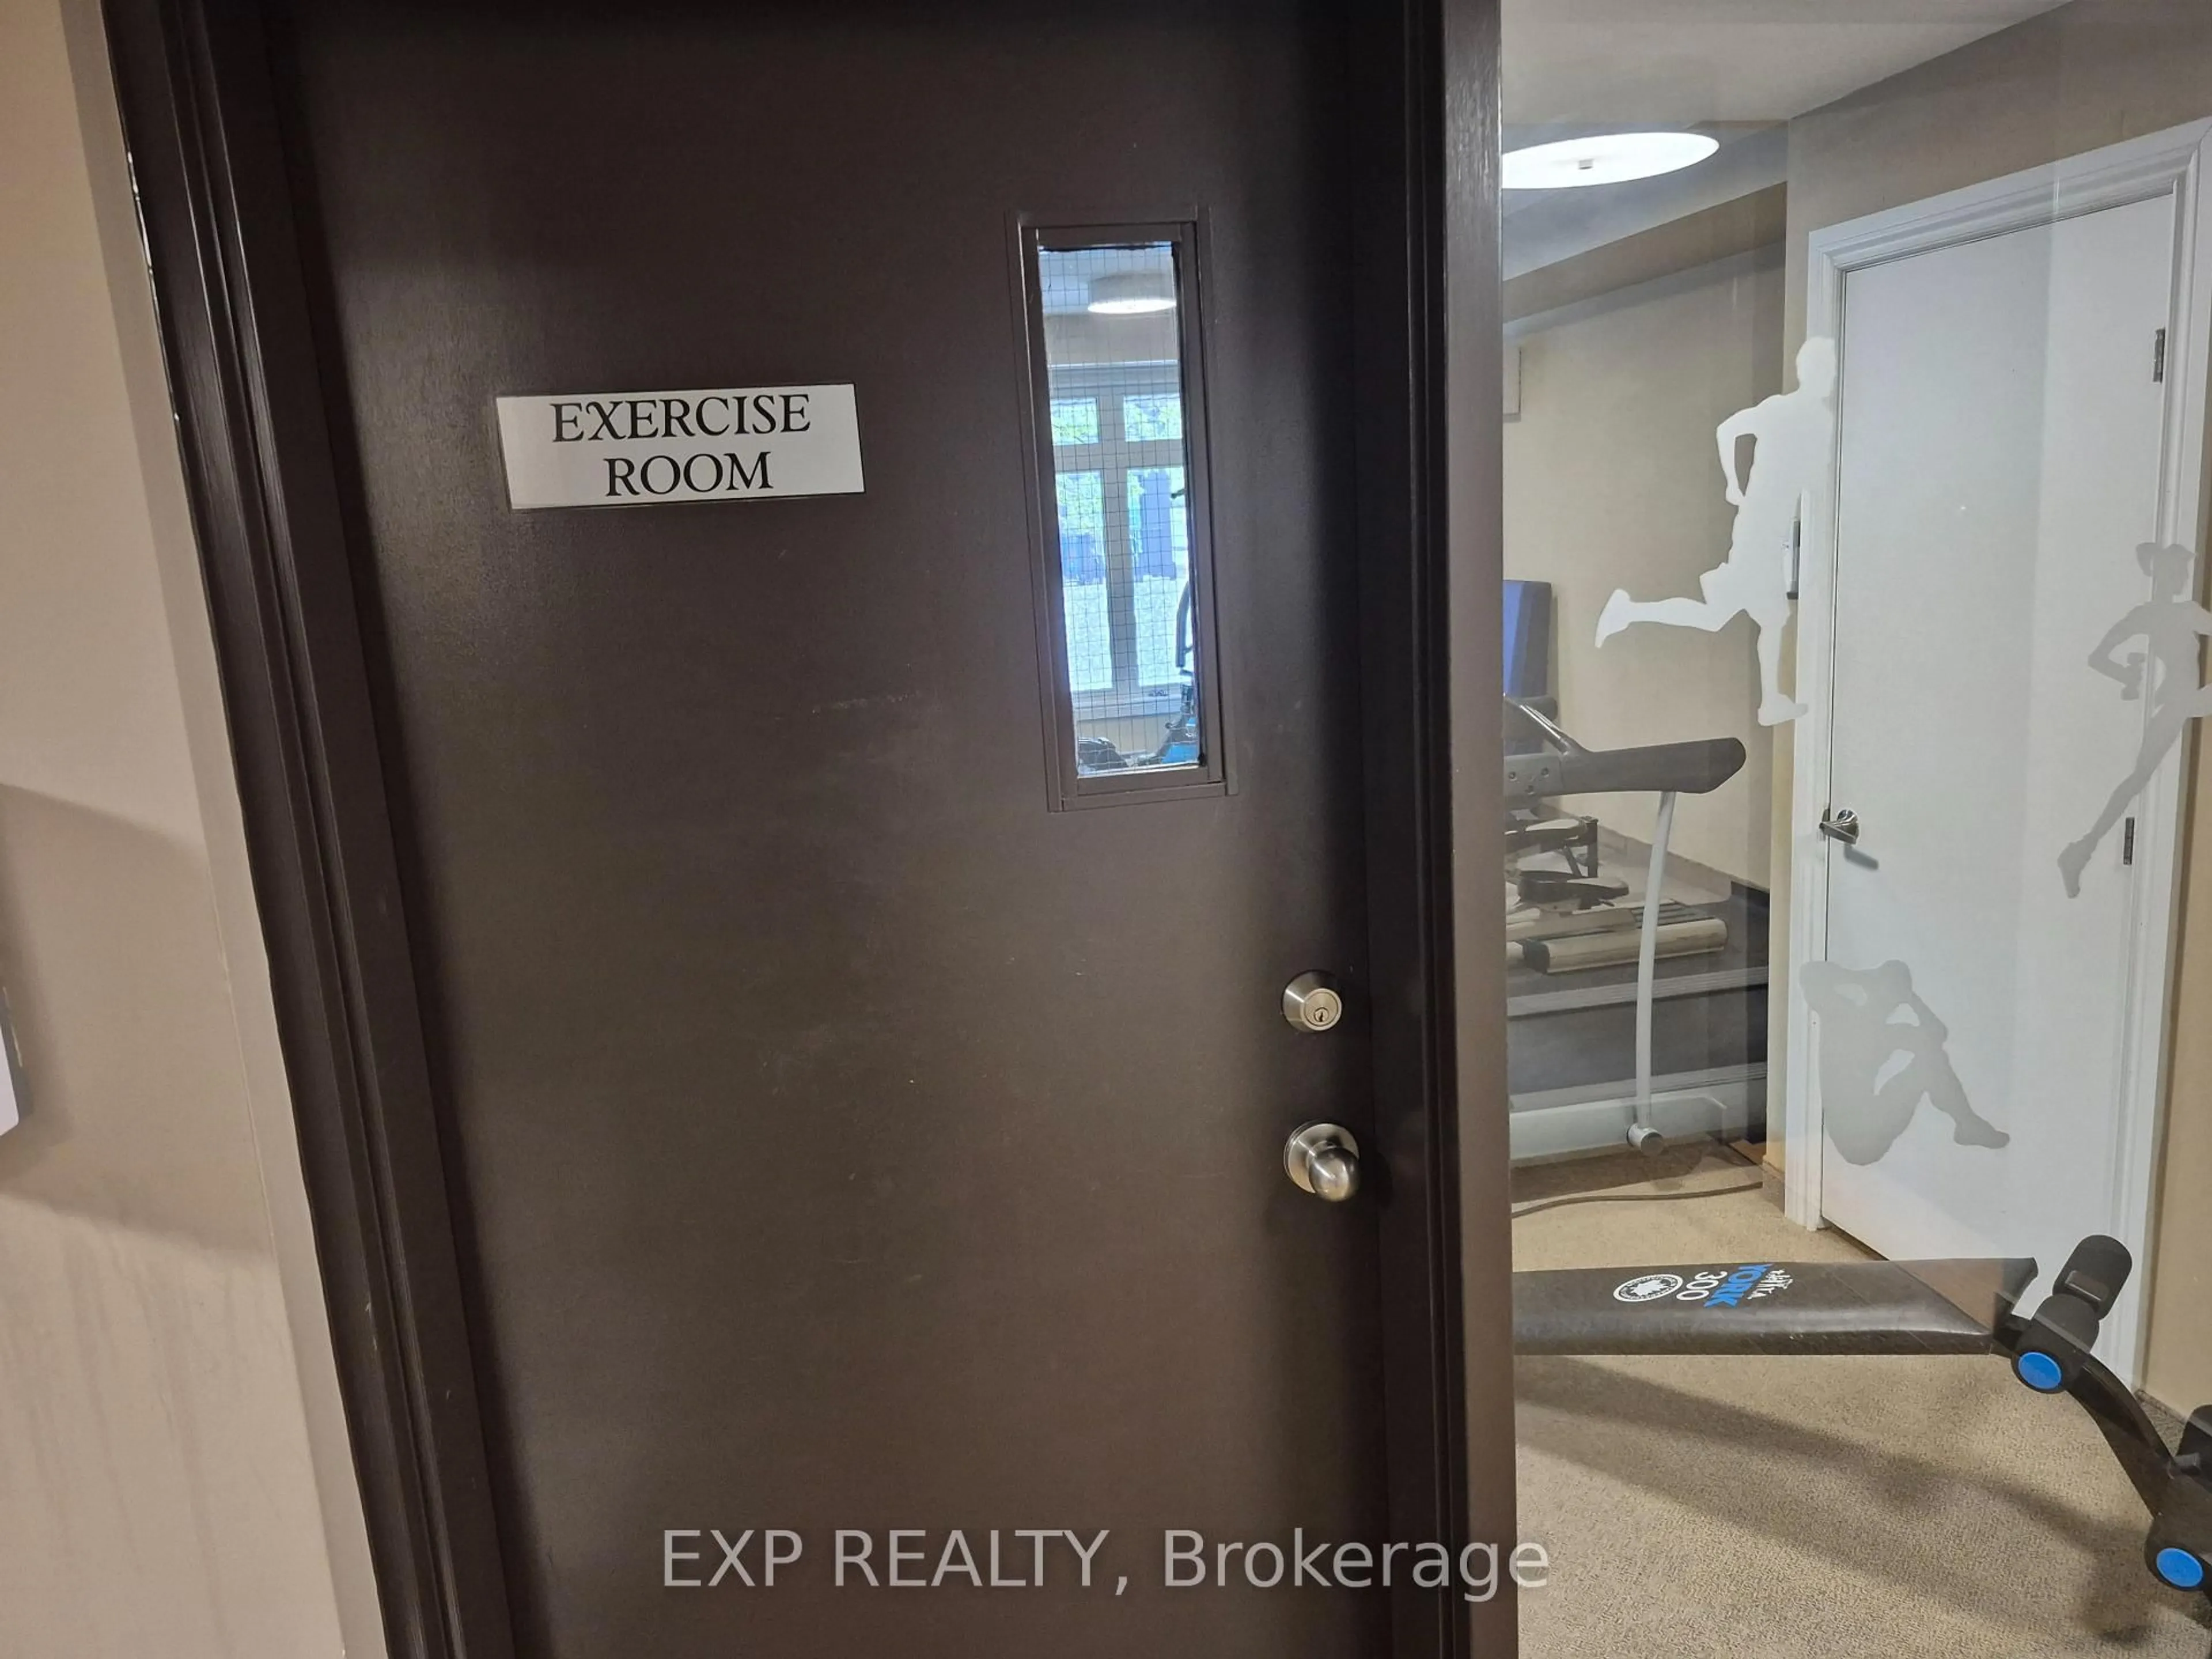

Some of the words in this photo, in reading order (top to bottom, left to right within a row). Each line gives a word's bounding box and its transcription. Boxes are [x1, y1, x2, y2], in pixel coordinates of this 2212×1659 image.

[550, 394, 811, 442] EXERCISE
[604, 451, 774, 497] ROOM
[1676, 1271, 1728, 1301] 300
[1704, 1264, 1772, 1307] YORK
